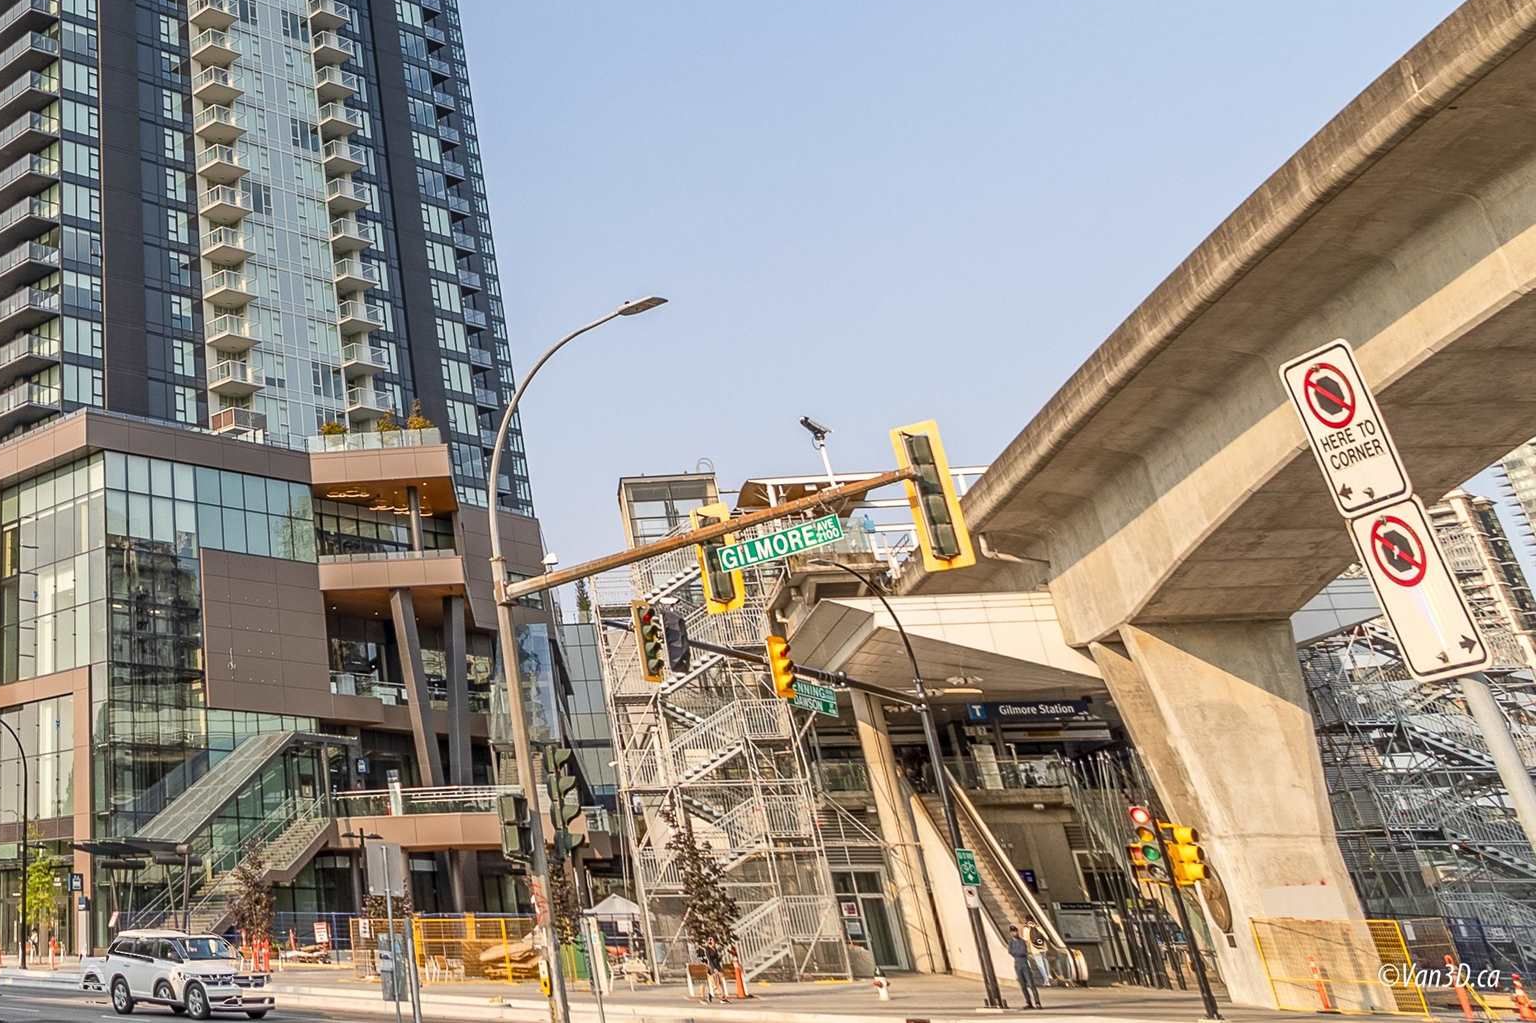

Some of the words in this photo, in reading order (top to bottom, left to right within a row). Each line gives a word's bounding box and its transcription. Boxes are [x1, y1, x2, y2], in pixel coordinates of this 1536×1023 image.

[1320, 427, 1356, 453] HERE
[1356, 419, 1376, 438] TO
[1330, 438, 1384, 470] CORNER
[816, 518, 834, 532] AVE
[817, 528, 840, 543] 2100
[721, 525, 818, 569] GILMORE
[792, 681, 825, 698] ENNING
[971, 705, 982, 716] T
[998, 705, 1037, 715] Gilmore
[1038, 704, 1075, 714] Station
